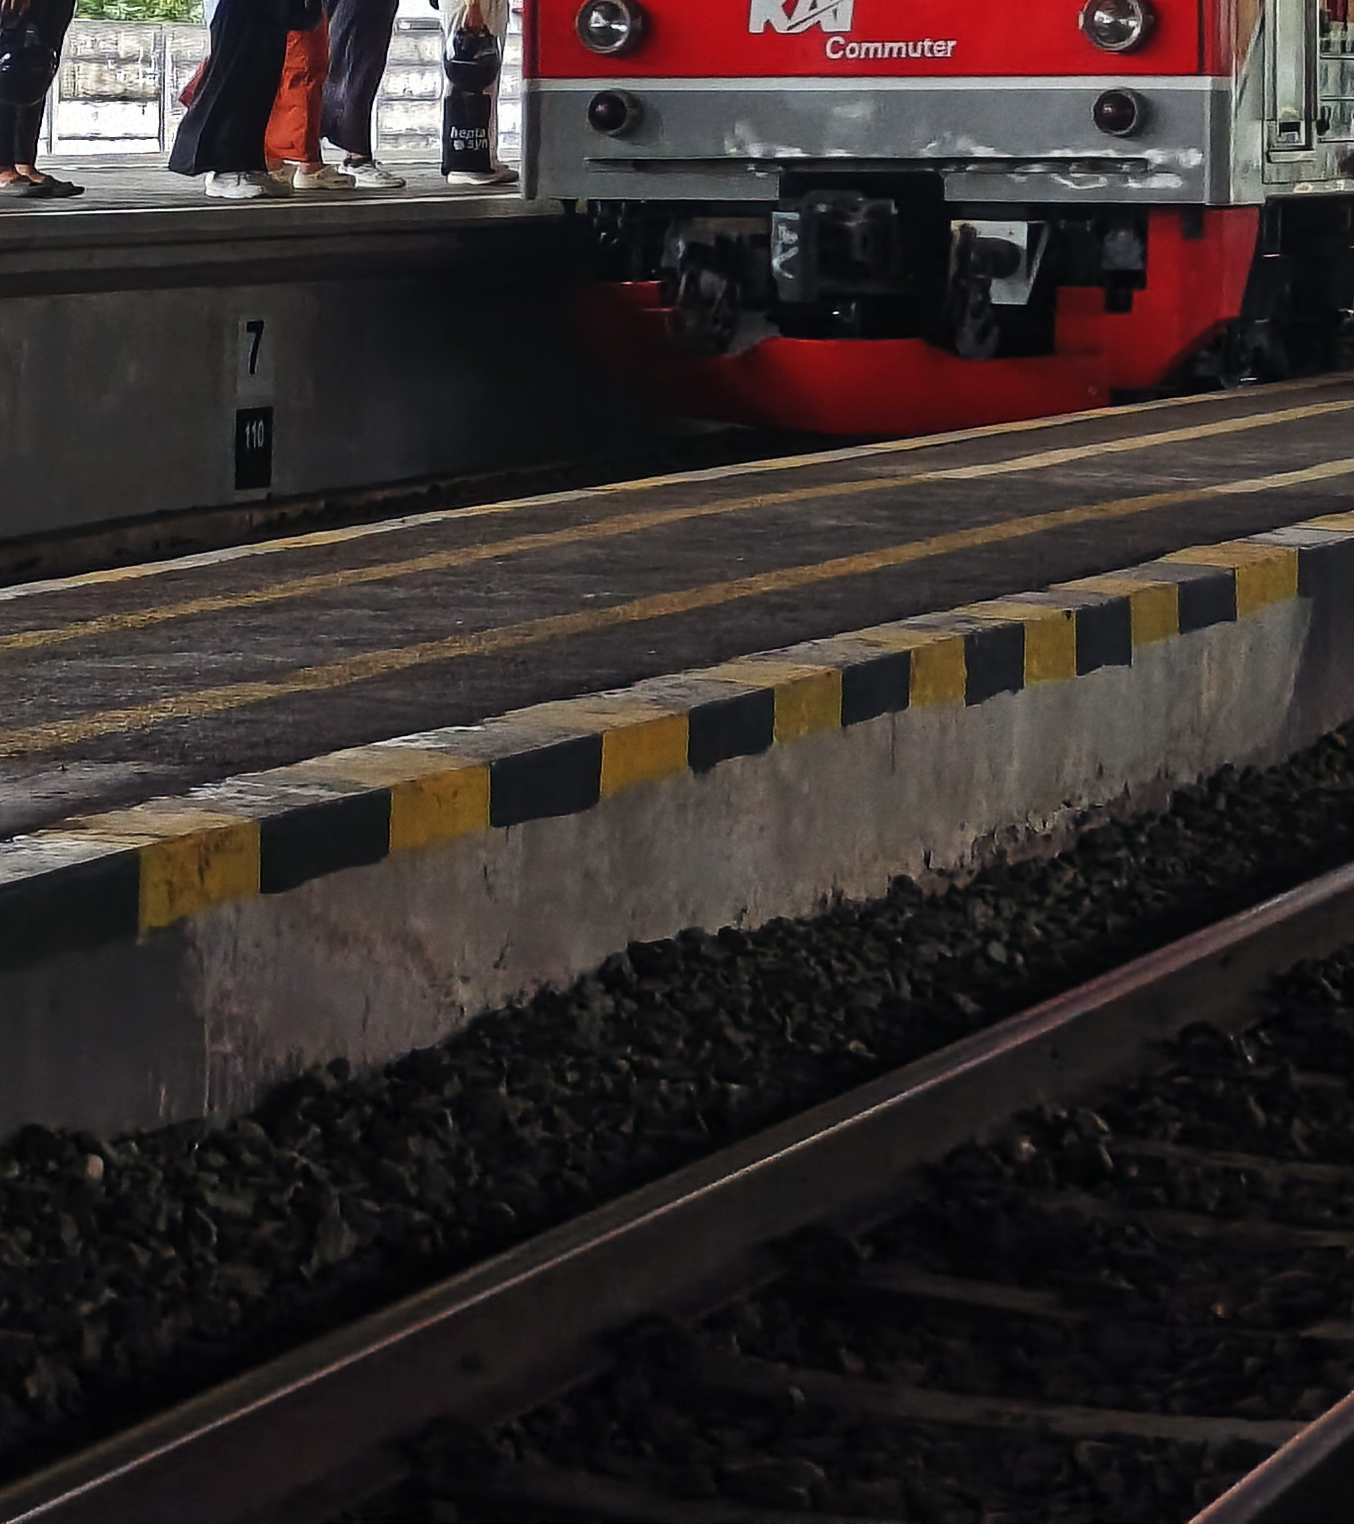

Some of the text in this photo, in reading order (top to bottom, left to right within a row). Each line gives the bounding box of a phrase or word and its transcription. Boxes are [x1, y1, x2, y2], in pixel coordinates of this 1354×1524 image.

[825, 36, 957, 59] Commuter
[246, 319, 264, 375] 7
[245, 420, 264, 449] 110
